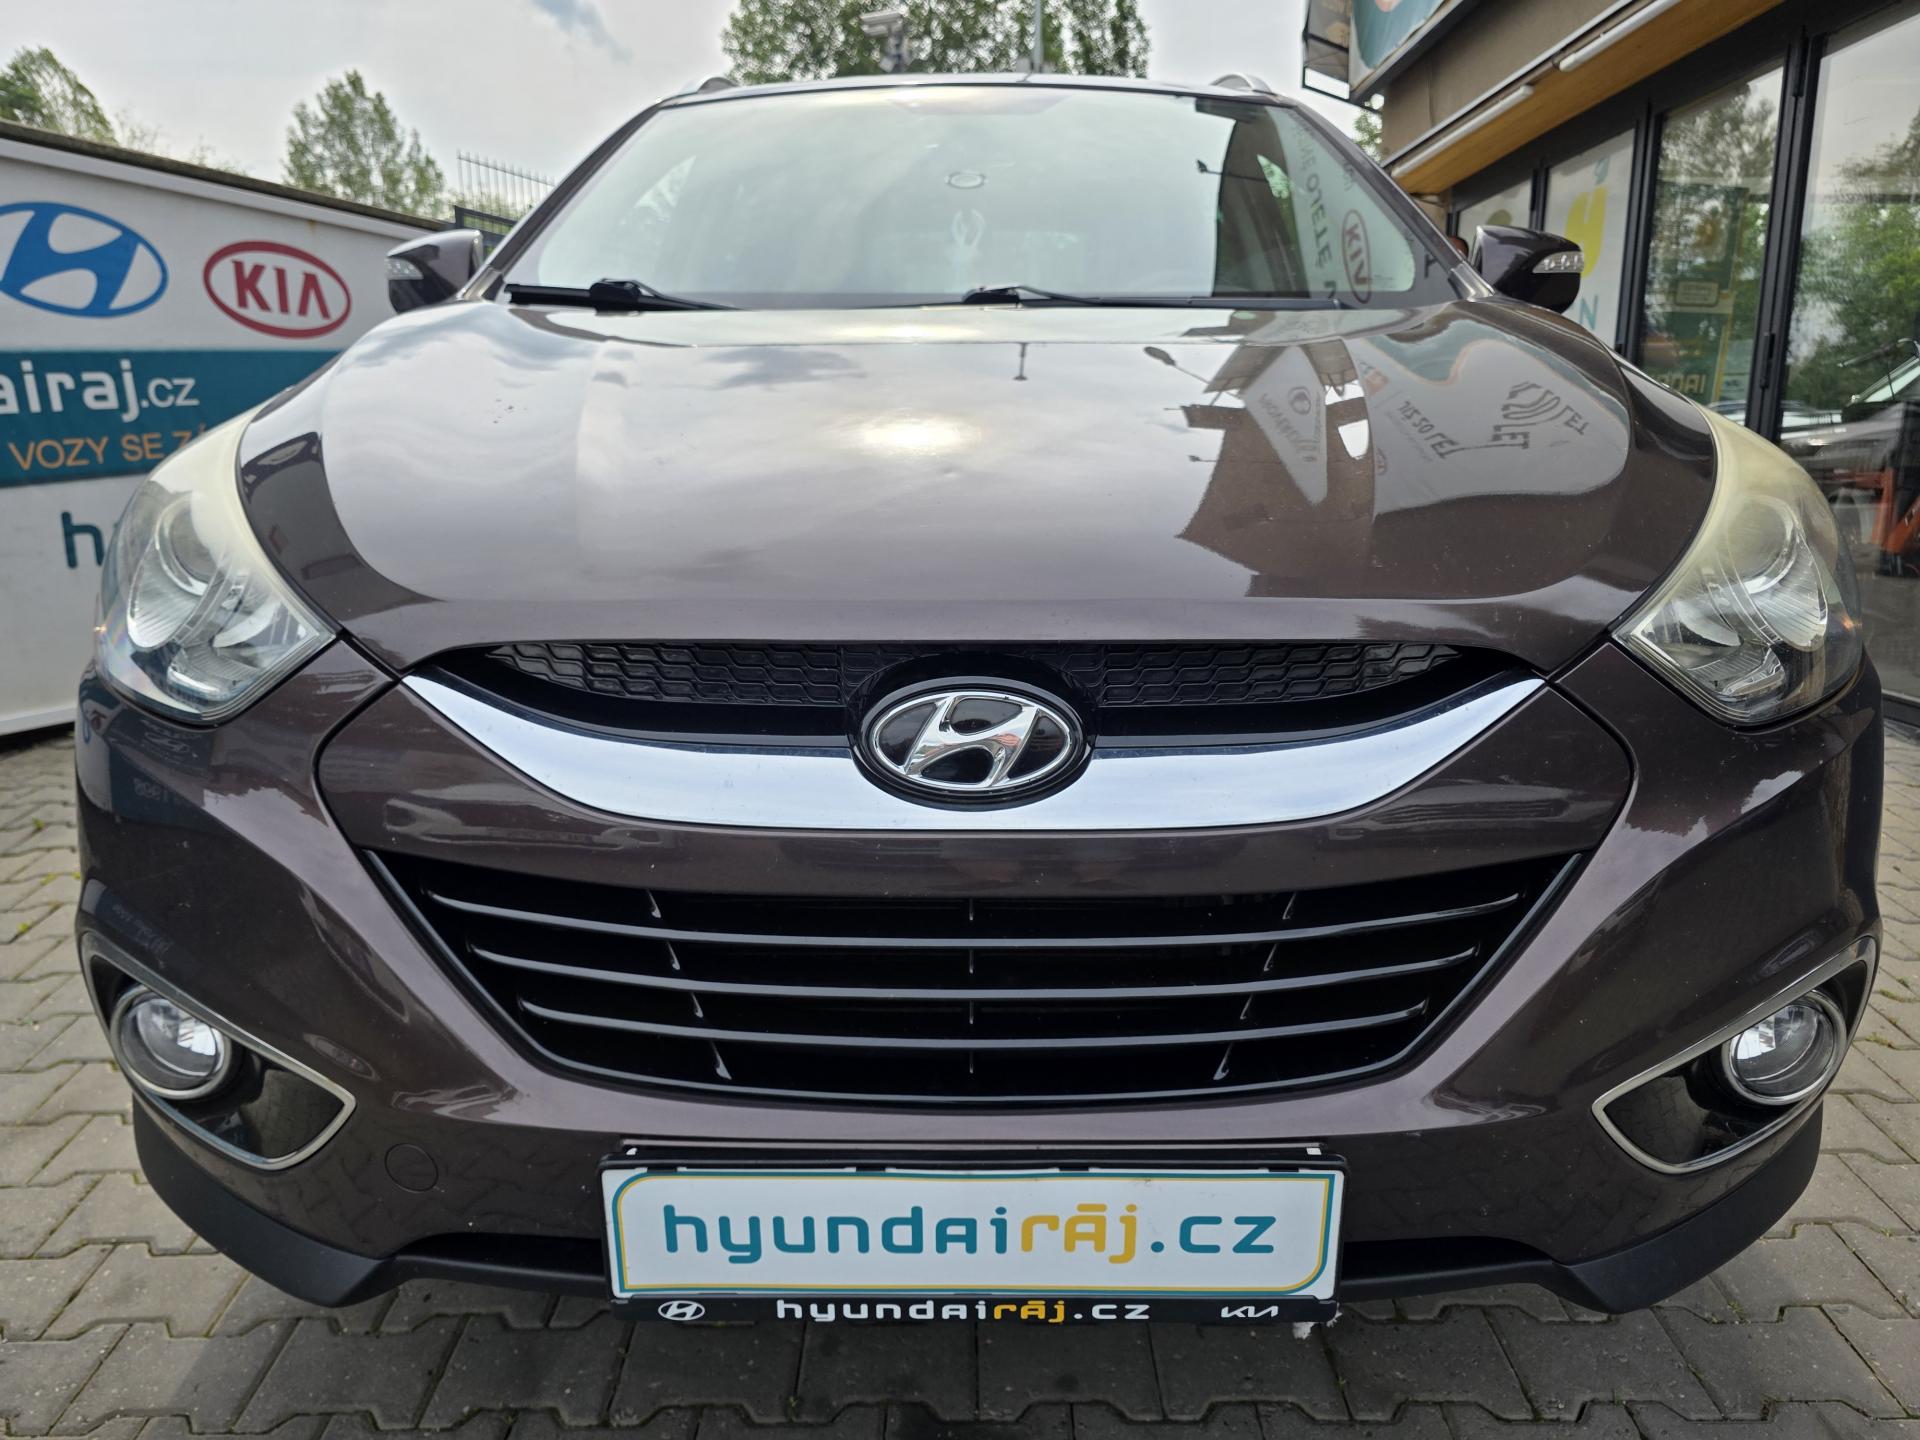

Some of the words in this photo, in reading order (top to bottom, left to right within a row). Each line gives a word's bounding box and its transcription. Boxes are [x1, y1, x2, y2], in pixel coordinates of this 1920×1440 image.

[232, 259, 331, 320] KIA
[8, 436, 109, 470] VOZY
[120, 432, 165, 462] SE
